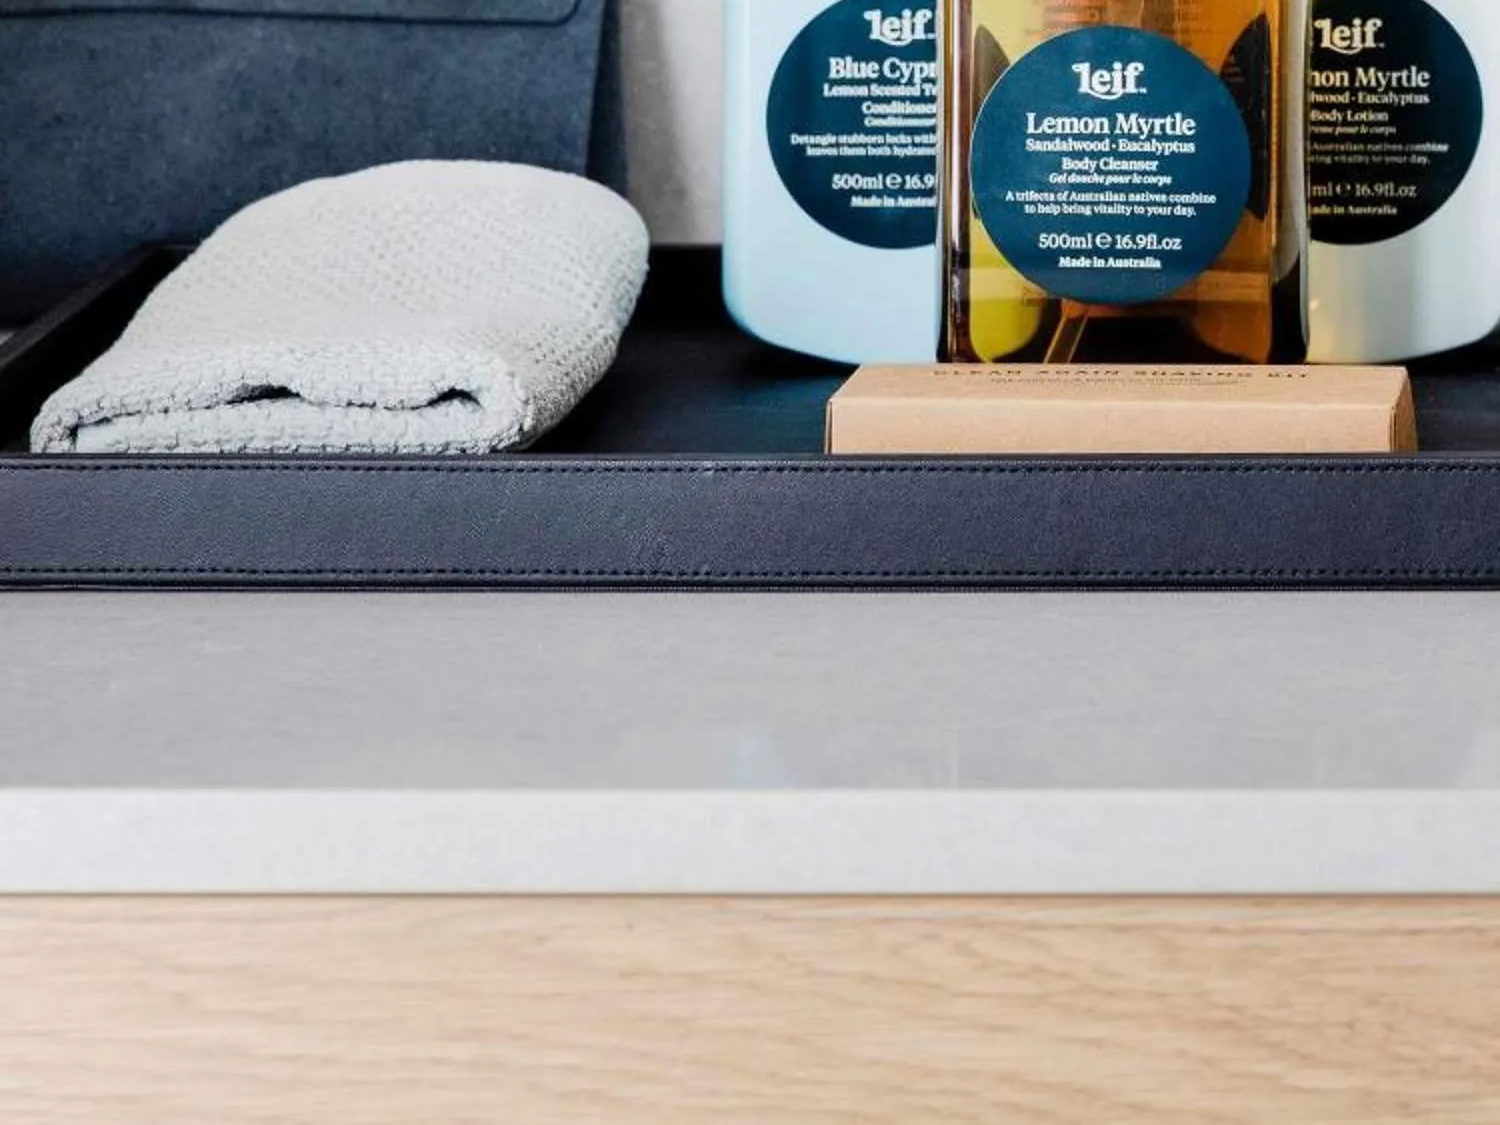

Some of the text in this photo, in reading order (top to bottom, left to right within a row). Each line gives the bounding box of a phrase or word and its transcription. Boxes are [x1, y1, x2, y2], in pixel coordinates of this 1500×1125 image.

[829, 57, 880, 79] Blue
[1355, 65, 1431, 92] Myrtle
[823, 83, 868, 96] Lemon
[870, 83, 920, 96] Scented
[1357, 91, 1430, 107] Eucalyptus
[1310, 109, 1389, 123] Body Lotion
[1026, 112, 1196, 139] Lemon Myrtle
[791, 132, 837, 145] Detangle
[838, 132, 884, 144] stubborn
[1025, 137, 1195, 155] Sandalwood Eucalyptus
[1062, 157, 1158, 173] Body Cleanser
[832, 173, 883, 189] 500ml
[904, 173, 937, 189] 16.9
[1050, 173, 1067, 184] Gel
[1067, 173, 1104, 184] douche
[1104, 175, 1132, 186] pour
[1143, 175, 1172, 186] corps
[851, 195, 882, 207] Made
[884, 195, 895, 207] in
[1005, 191, 1216, 204] A trifecta of Australian natives combine
[1024, 203, 1196, 217] to help bring vitality to your day.
[1333, 205, 1345, 215] in
[1347, 204, 1398, 216] Australia
[1038, 233, 1092, 250] 500ml
[1115, 233, 1182, 251] 16.9fl.oz
[1058, 257, 1161, 269] Made in Australia
